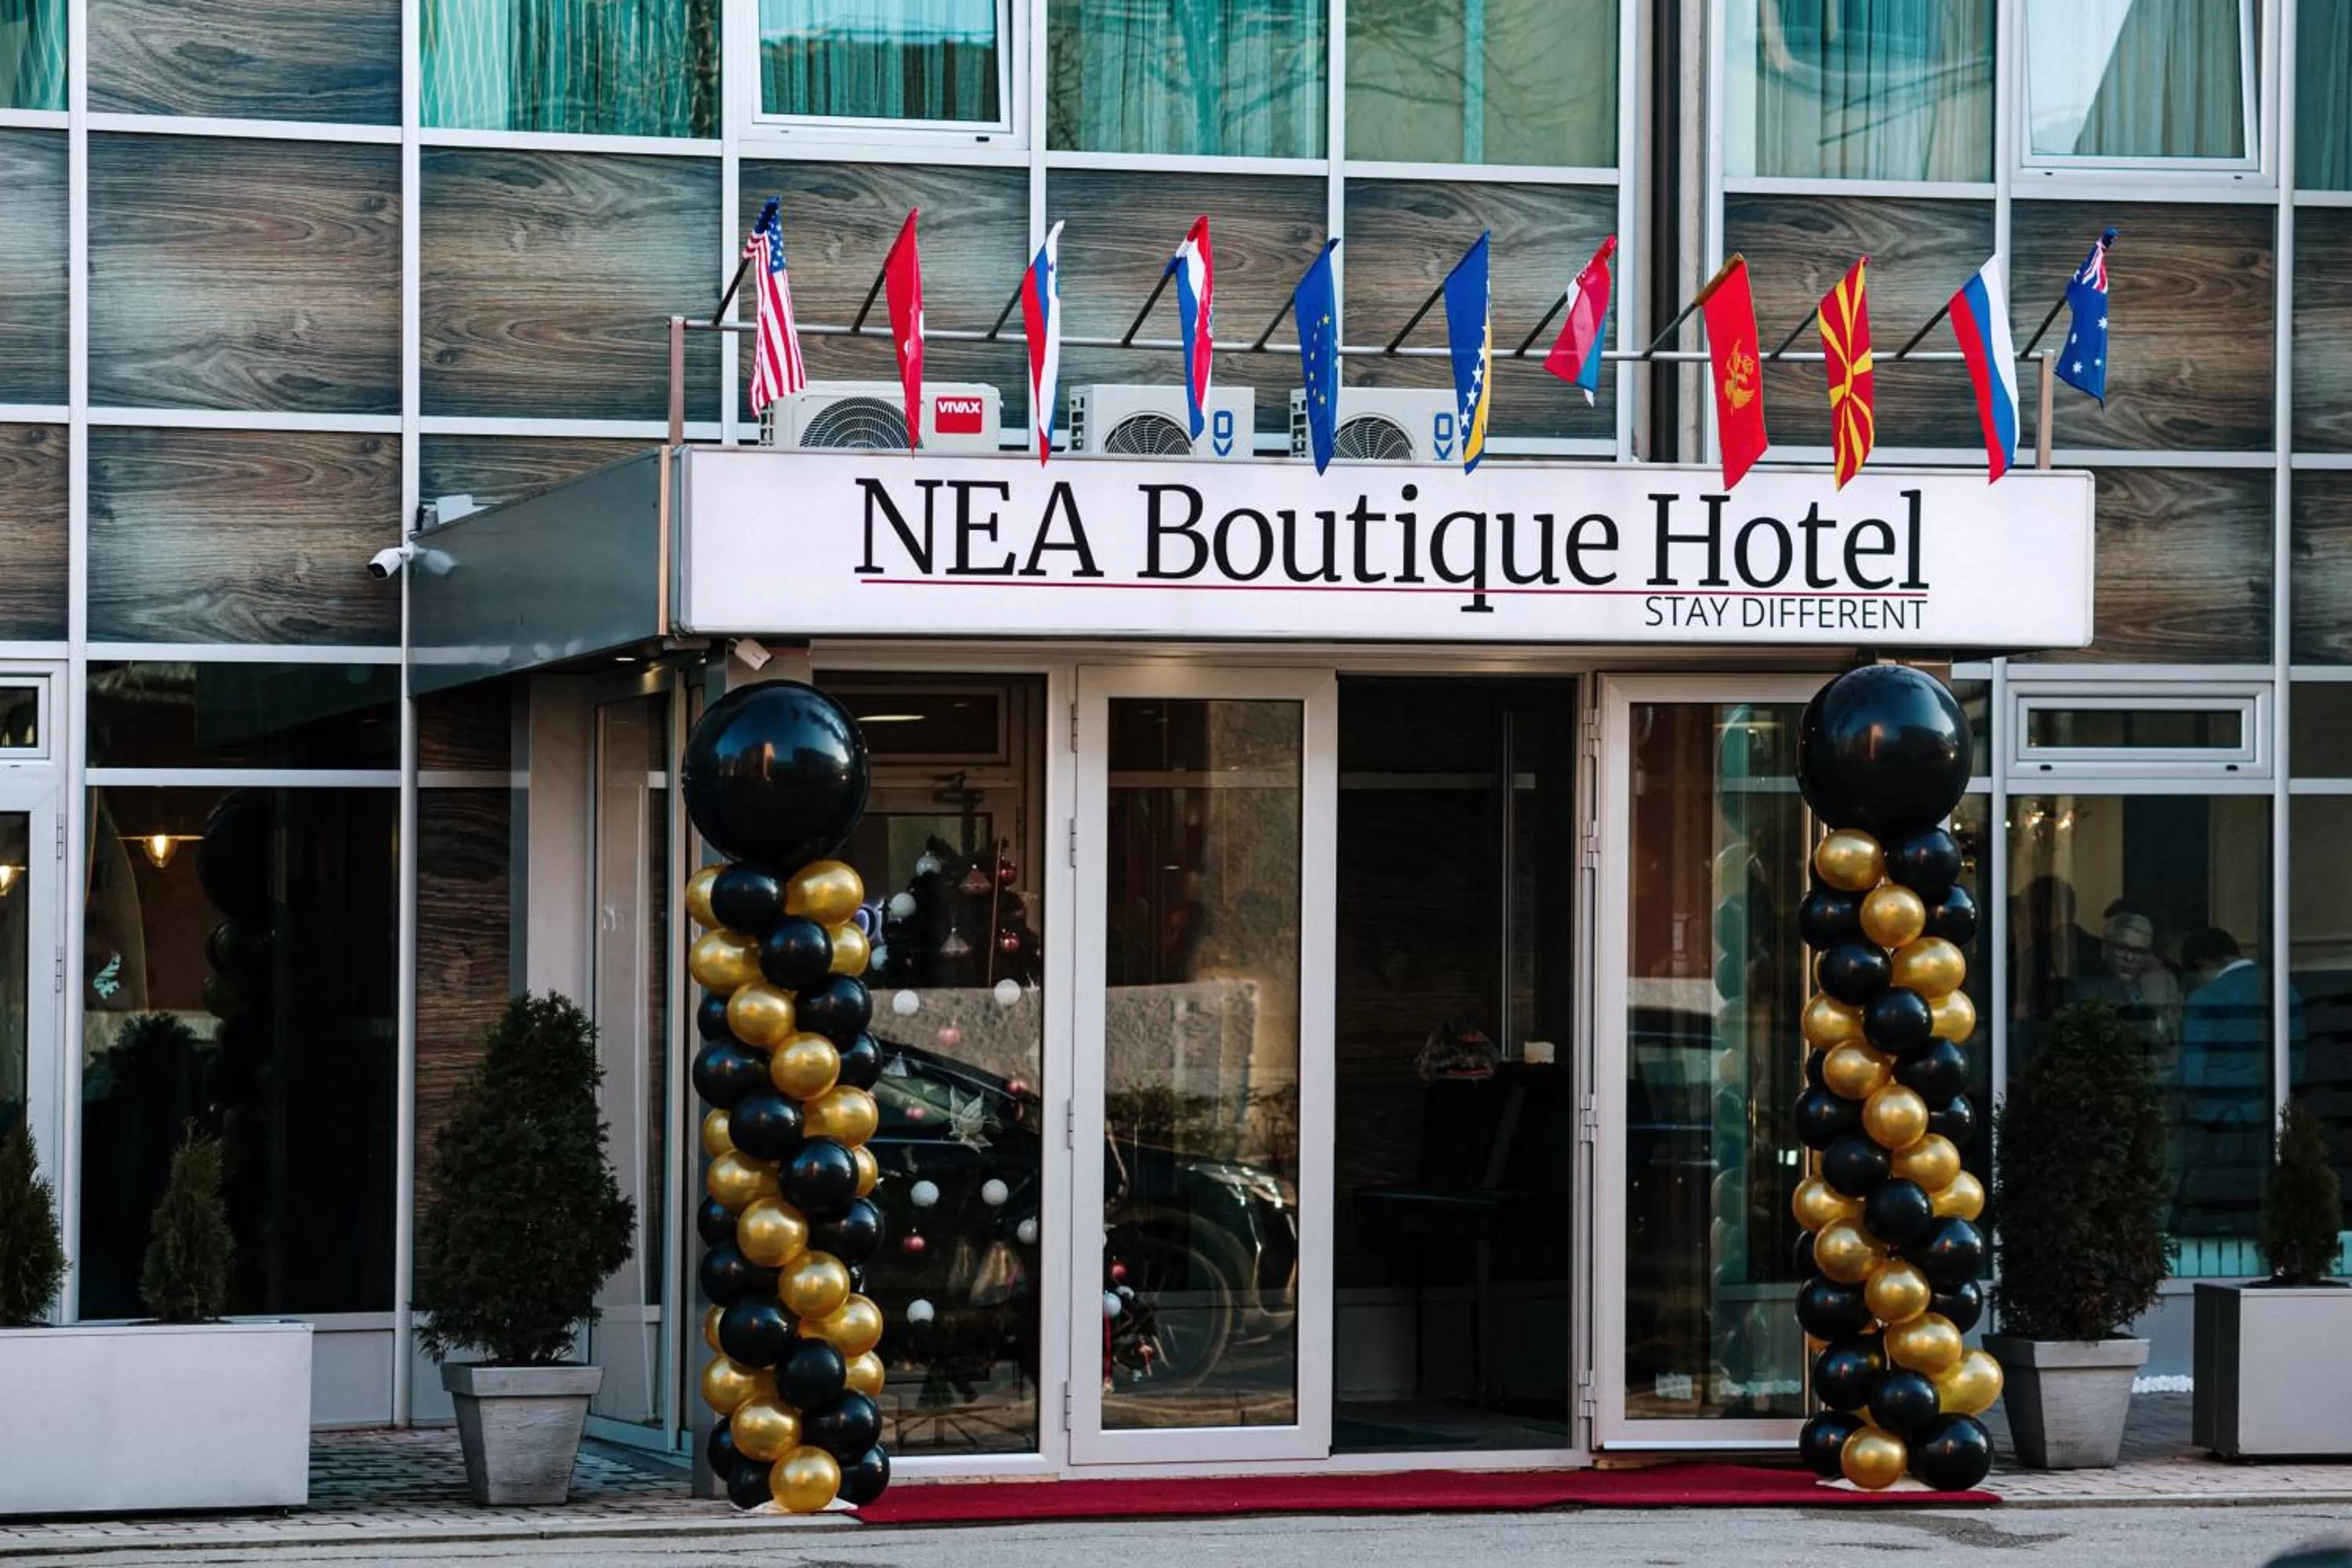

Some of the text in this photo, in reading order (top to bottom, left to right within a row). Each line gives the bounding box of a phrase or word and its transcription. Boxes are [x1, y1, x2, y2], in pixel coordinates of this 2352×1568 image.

[937, 401, 982, 414] VIVAX
[854, 477, 1929, 612] NEA Boutique Hotel
[1646, 596, 1928, 629] STAY DIFFERENT
